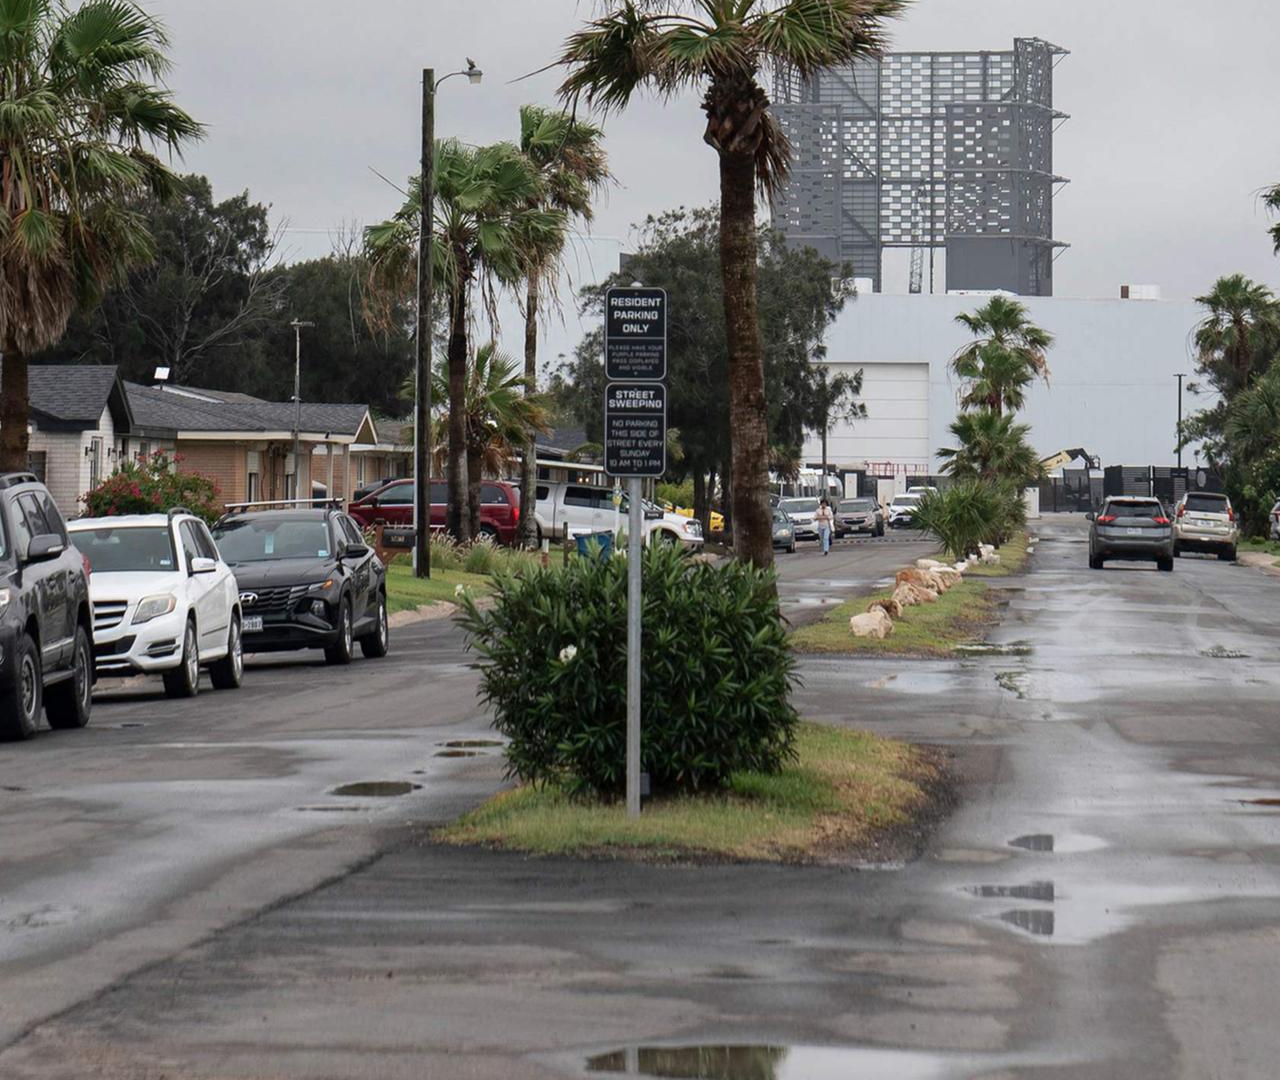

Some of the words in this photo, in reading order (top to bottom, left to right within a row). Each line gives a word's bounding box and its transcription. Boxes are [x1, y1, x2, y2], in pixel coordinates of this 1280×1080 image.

[611, 298, 662, 307] RESIDENT
[614, 311, 658, 320] PARKING
[622, 324, 649, 333] ONLY
[615, 390, 655, 399] STREET
[608, 399, 662, 408] SWEEPING
